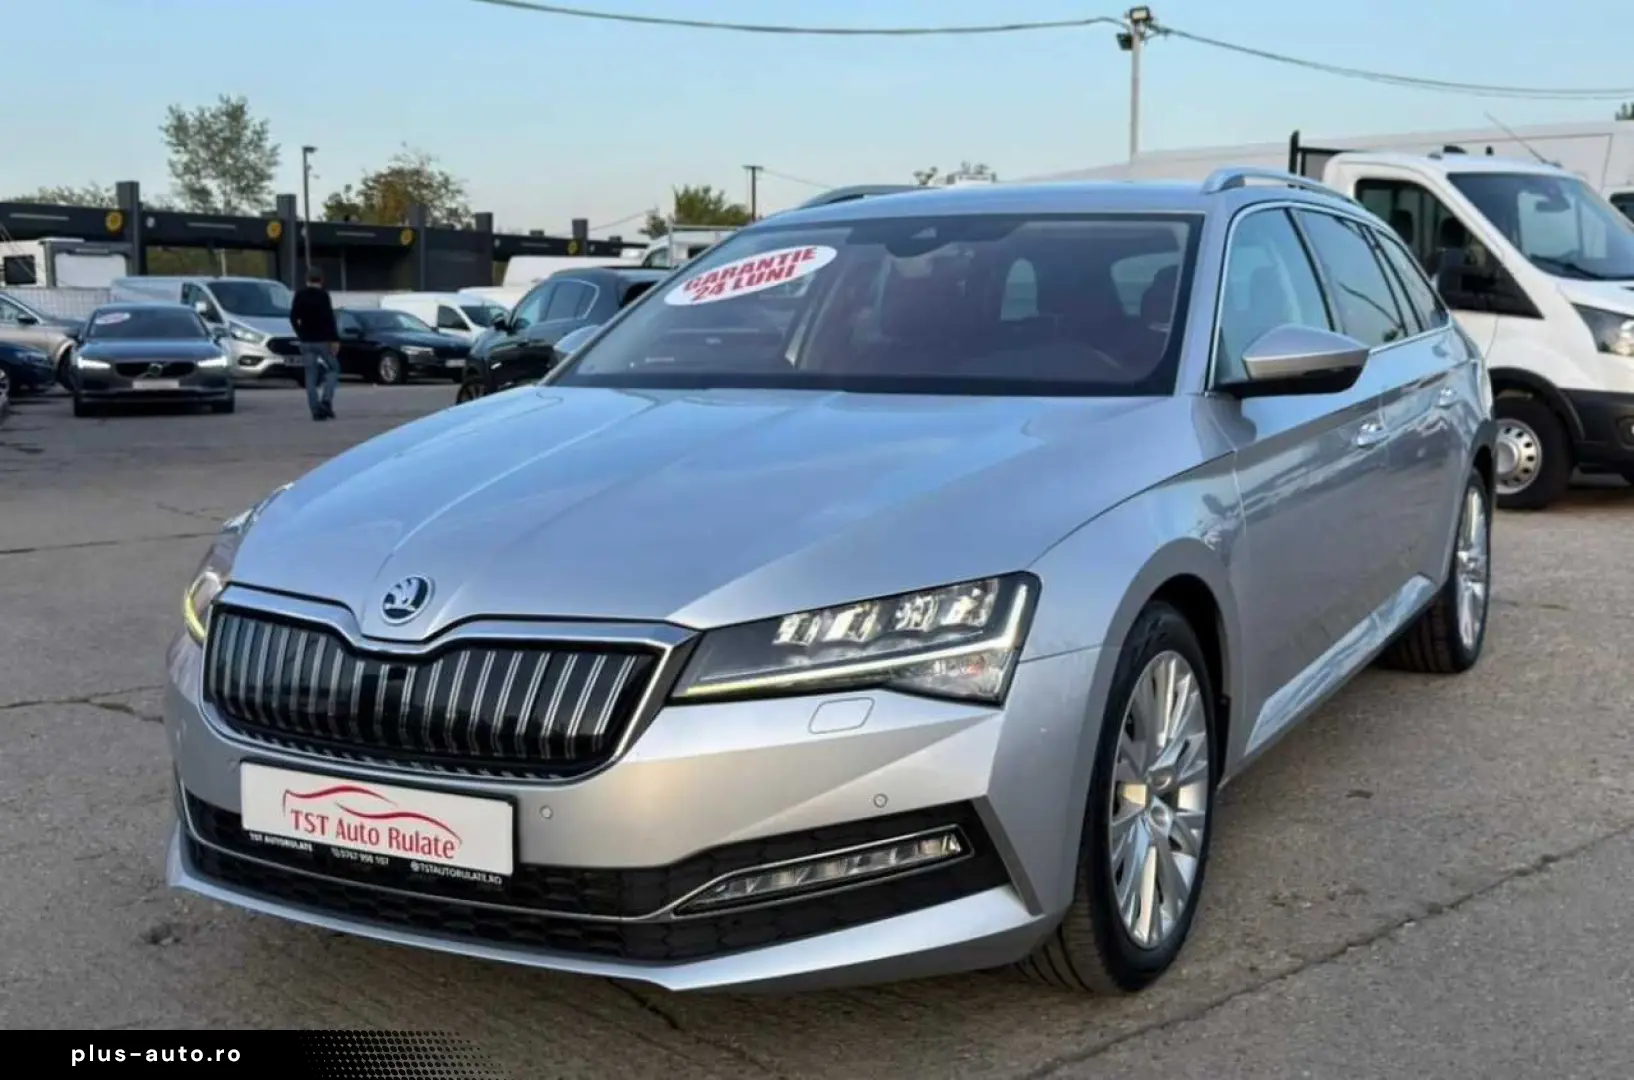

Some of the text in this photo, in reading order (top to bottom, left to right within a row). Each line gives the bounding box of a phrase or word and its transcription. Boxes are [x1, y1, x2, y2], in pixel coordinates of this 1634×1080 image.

[683, 247, 817, 292] GARANTIE
[691, 264, 795, 301] 24 LUNI
[290, 808, 455, 859] TST Auto Rulate
